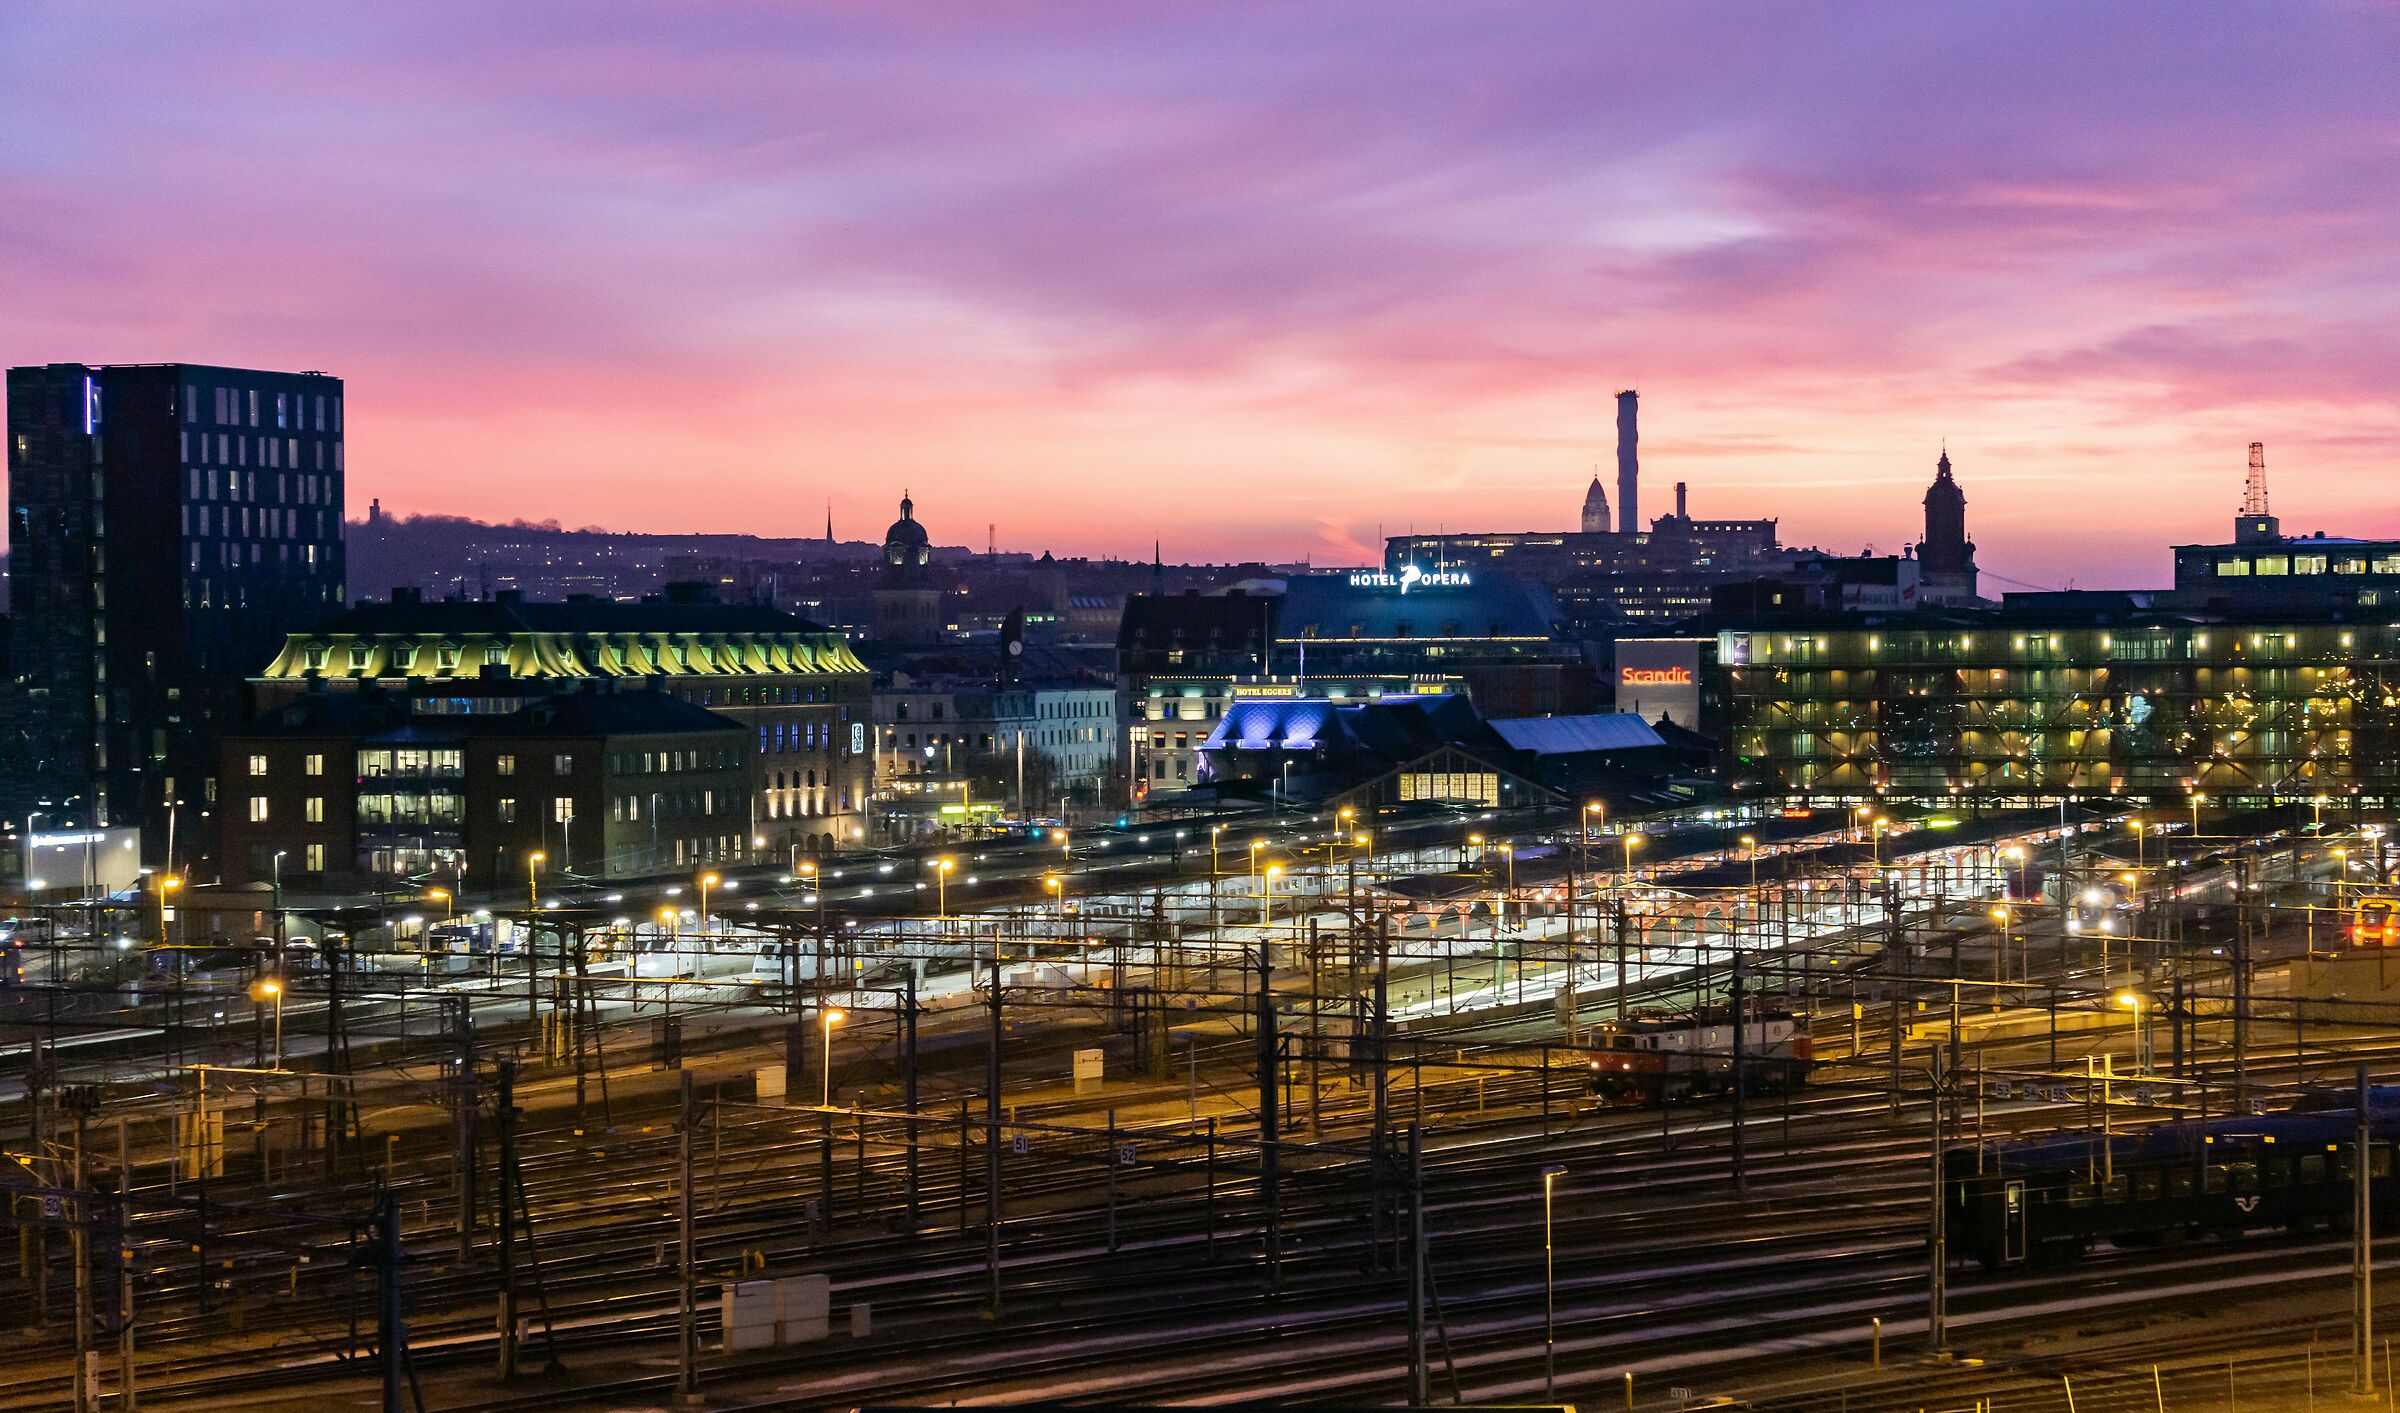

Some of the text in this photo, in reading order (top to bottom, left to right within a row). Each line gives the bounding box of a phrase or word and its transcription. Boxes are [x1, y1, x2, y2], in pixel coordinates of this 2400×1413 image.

[1350, 573, 1471, 586] HOTEL OPERA
[1622, 666, 1692, 684] Scandic
[1236, 687, 1292, 696] HOTEL EGGERS
[1997, 1084, 2010, 1096] 53
[2024, 1086, 2037, 1098] 54
[2052, 1088, 2065, 1099] 55
[2137, 1091, 2149, 1103] 56
[2253, 1100, 2265, 1111] 57
[1015, 1138, 1026, 1150] 51
[1122, 1149, 1134, 1161] 52
